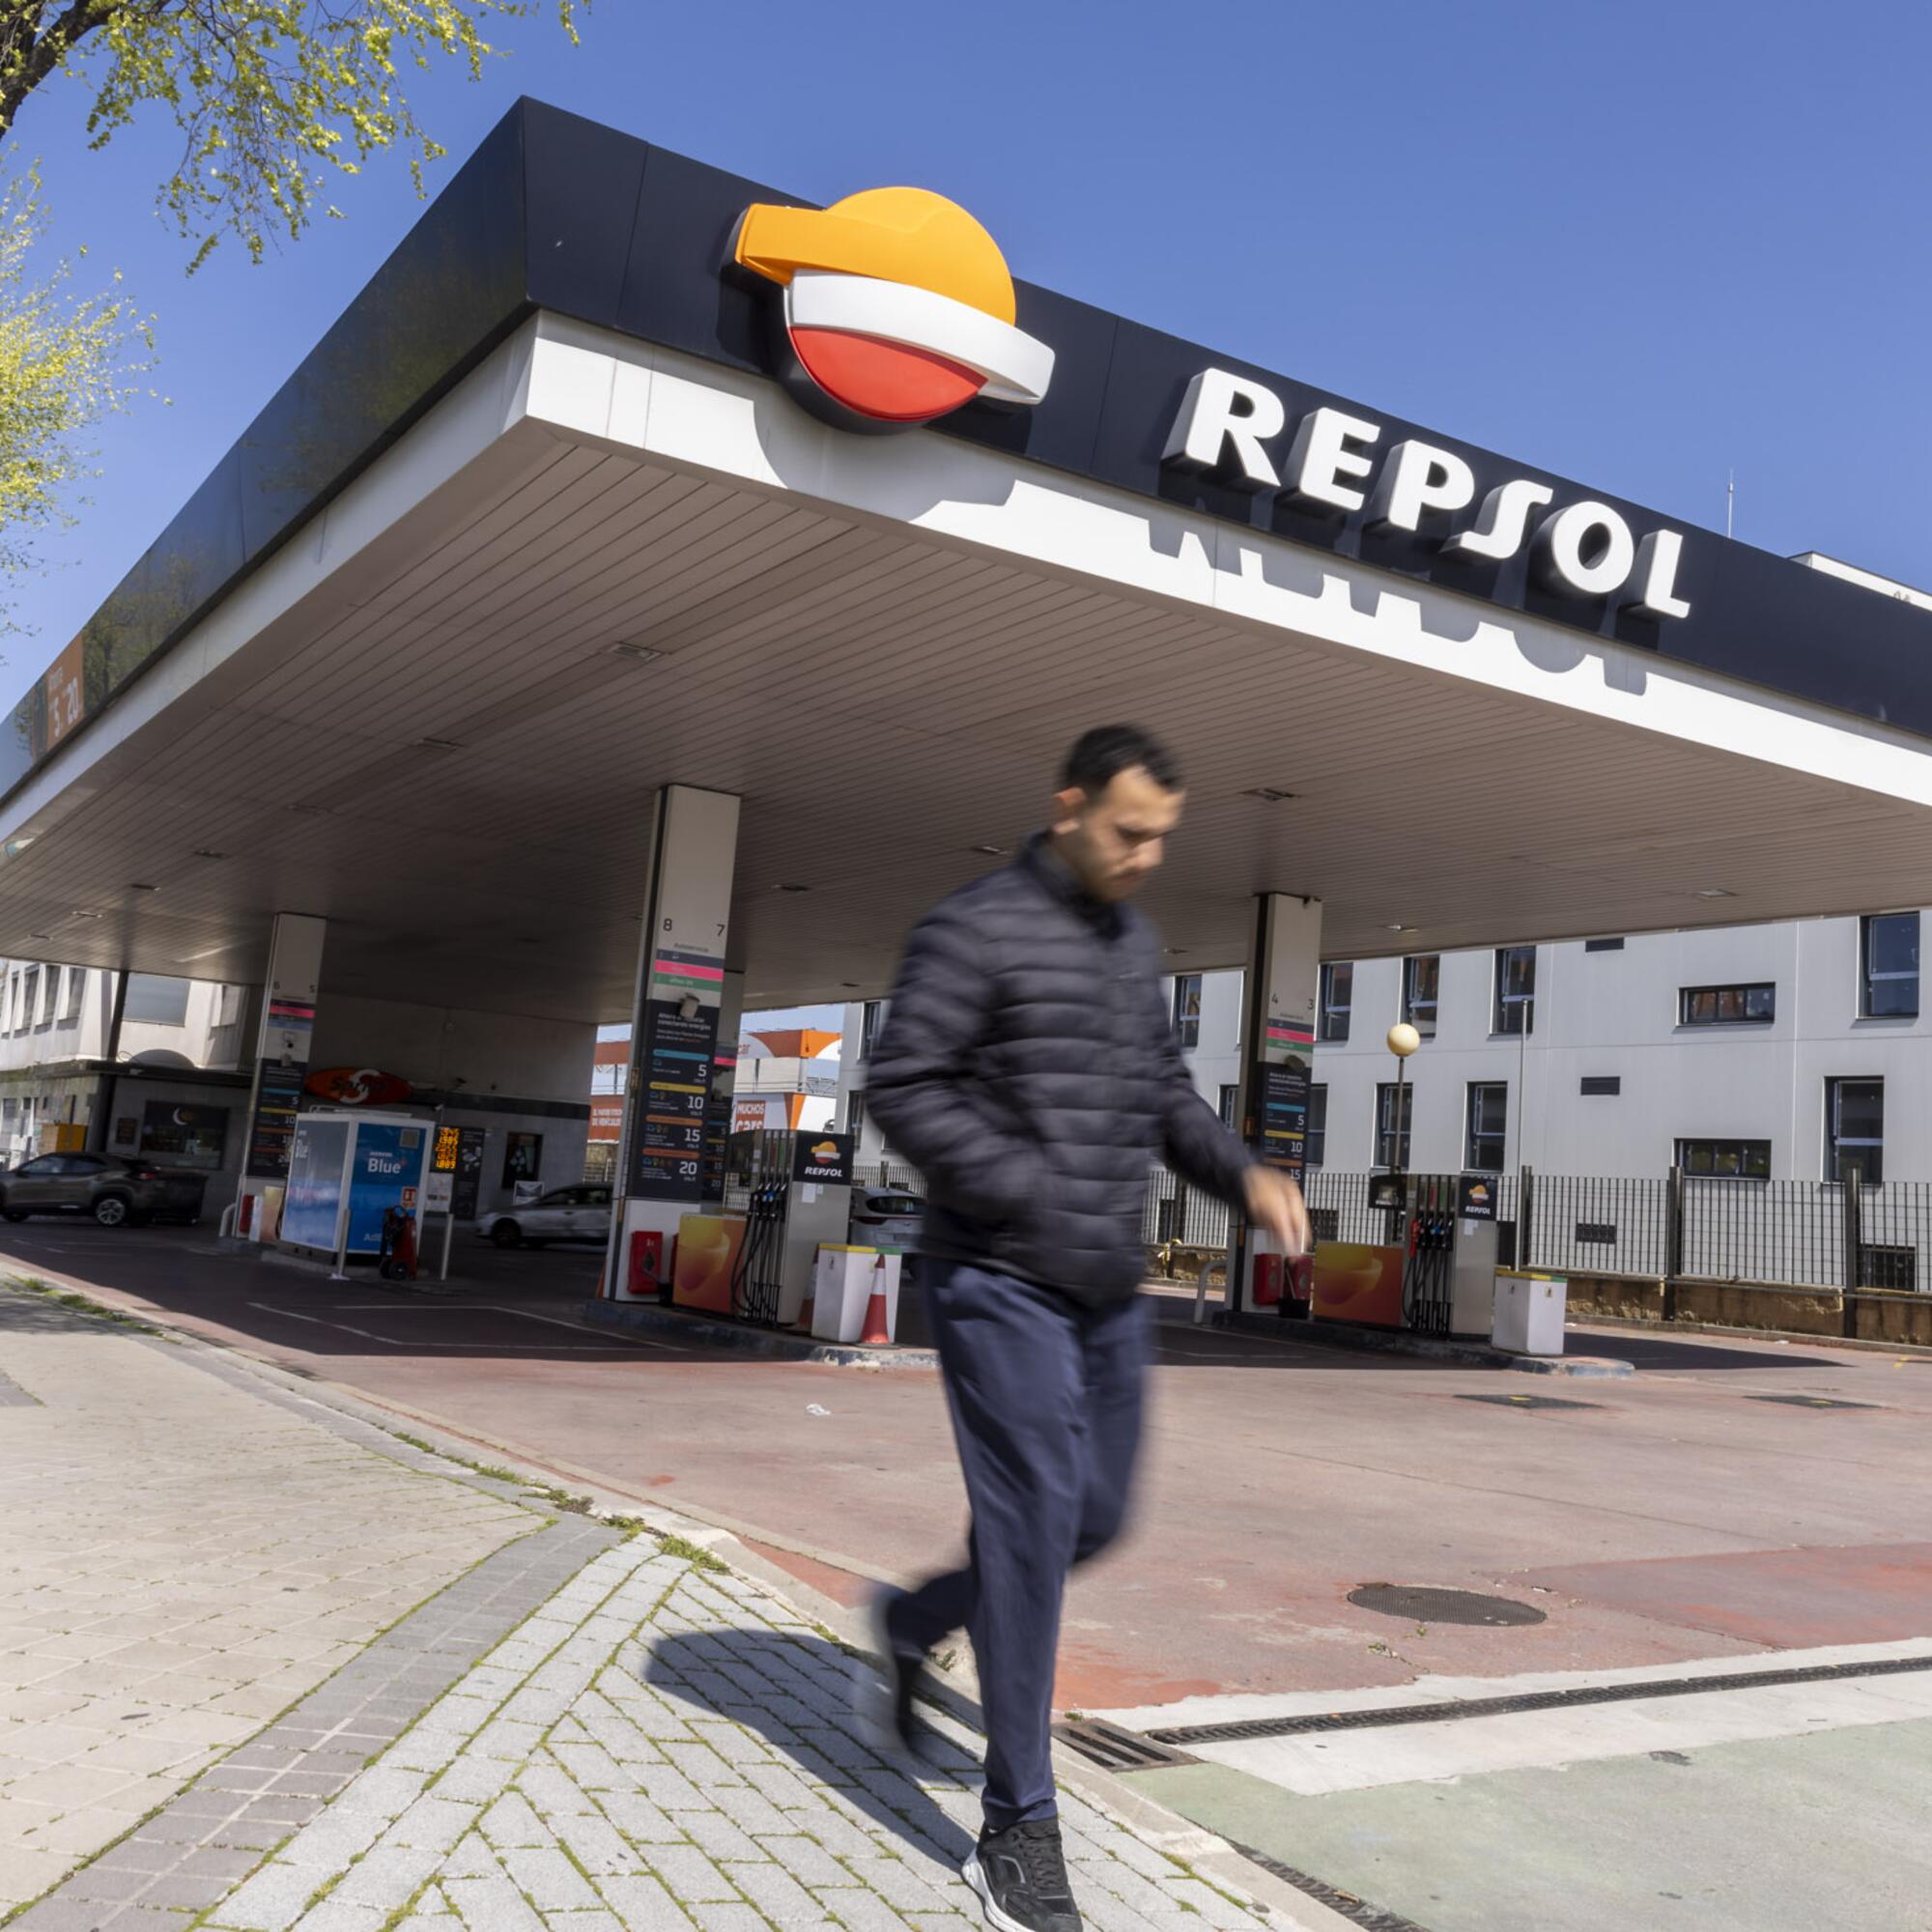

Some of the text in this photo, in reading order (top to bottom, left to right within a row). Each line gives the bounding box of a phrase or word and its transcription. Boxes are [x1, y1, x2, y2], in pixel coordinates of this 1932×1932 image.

[1182, 366, 1692, 619] REPSOL
[663, 918, 725, 938] 8 7
[1271, 993, 1315, 1010] 4 3
[697, 1065, 707, 1078] 5
[292, 1096, 298, 1105] 5
[687, 1095, 704, 1110] 10
[737, 1102, 765, 1115] MUCHOS
[1297, 1115, 1304, 1126] 5
[684, 1128, 701, 1143] 15
[1291, 1141, 1303, 1153] 10
[367, 1157, 402, 1175] Blue
[679, 1161, 697, 1176] 20
[804, 1166, 843, 1178] REPSOL
[1290, 1168, 1301, 1180] 15
[1464, 1206, 1492, 1216] REPSOL
